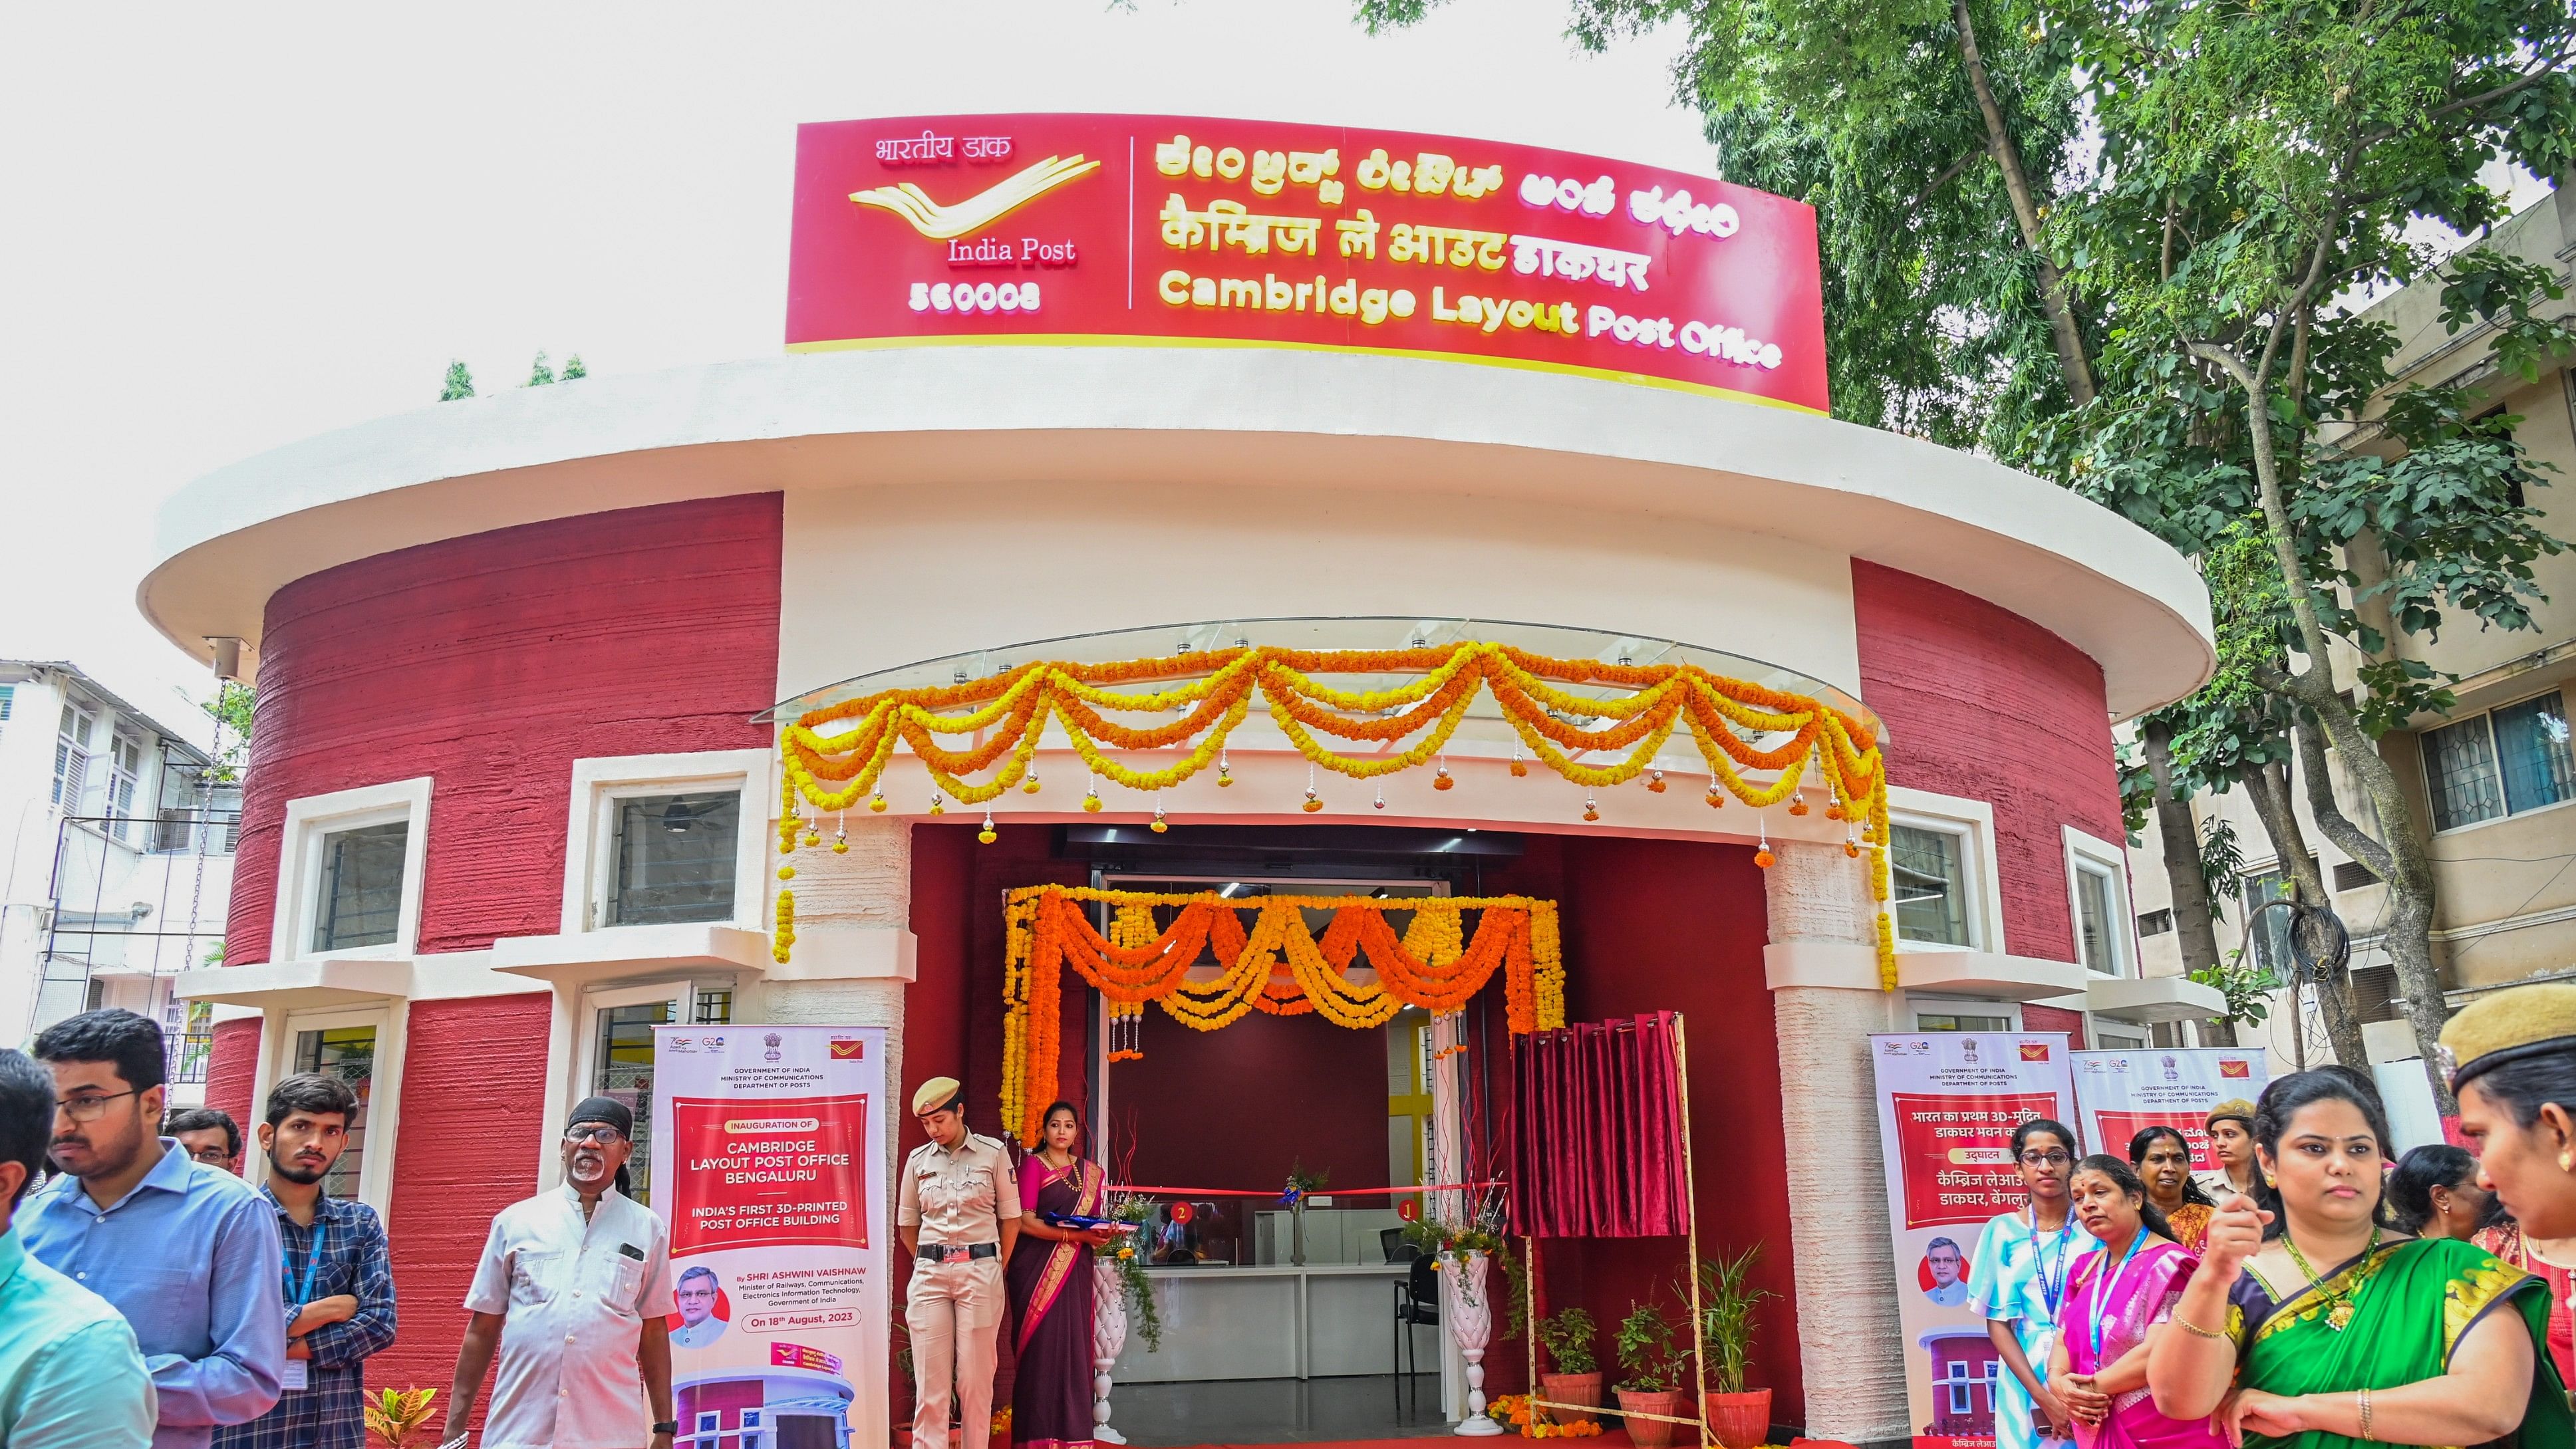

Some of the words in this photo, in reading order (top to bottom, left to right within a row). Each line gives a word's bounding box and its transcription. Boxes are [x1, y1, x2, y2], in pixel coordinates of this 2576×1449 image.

[875, 130, 954, 161] भारतीय
[962, 136, 1012, 158] डाक
[948, 239, 1012, 261] India
[1021, 237, 1076, 261] Post
[1509, 235, 1651, 291] डाकघर
[909, 283, 1040, 311] 560008
[1159, 269, 1416, 325] Cambridge
[1432, 287, 1580, 334] Layout
[1588, 305, 1675, 348] Post
[1679, 321, 1783, 369] Office
[1912, 1112, 1941, 1122] भारत
[1942, 1112, 1960, 1122] का
[1961, 1112, 1988, 1122] प्रथम
[1934, 1127, 1975, 1138] डाकघर
[1975, 1127, 2003, 1138] भवन
[2003, 1127, 2018, 1137] क
[727, 1140, 815, 1154] CAMBRIDGE
[690, 1157, 750, 1170] LAYOUT
[755, 1156, 793, 1168] POST
[797, 1154, 849, 1166] OFFICE
[1964, 1151, 2000, 1162] उद्घाटन
[726, 1169, 817, 1184] BENGALURU
[1936, 1170, 1983, 1187] कैम्ब्रिज
[1984, 1170, 2027, 1186] लेआउ
[1938, 1193, 1989, 1207] डाकघर,
[739, 1204, 773, 1216] FIRST
[777, 1202, 847, 1214] 3D-PRINTED
[1178, 1207, 1185, 1219] 2
[1403, 1204, 1411, 1219] 1
[700, 1218, 732, 1230] POST
[736, 1216, 780, 1228] OFFICE
[784, 1214, 840, 1227] BUILDING
[746, 1273, 769, 1281] SHRI
[772, 1269, 813, 1279] ASHWINI
[817, 1267, 866, 1277] VAISHNAW
[808, 1278, 865, 1287] Communications,
[822, 1287, 861, 1296] Technology,
[769, 1317, 786, 1325] 18th
[787, 1314, 825, 1326] August,
[828, 1312, 853, 1321] 2023
[1951, 1438, 1975, 1448] कैम्ब्रिज
